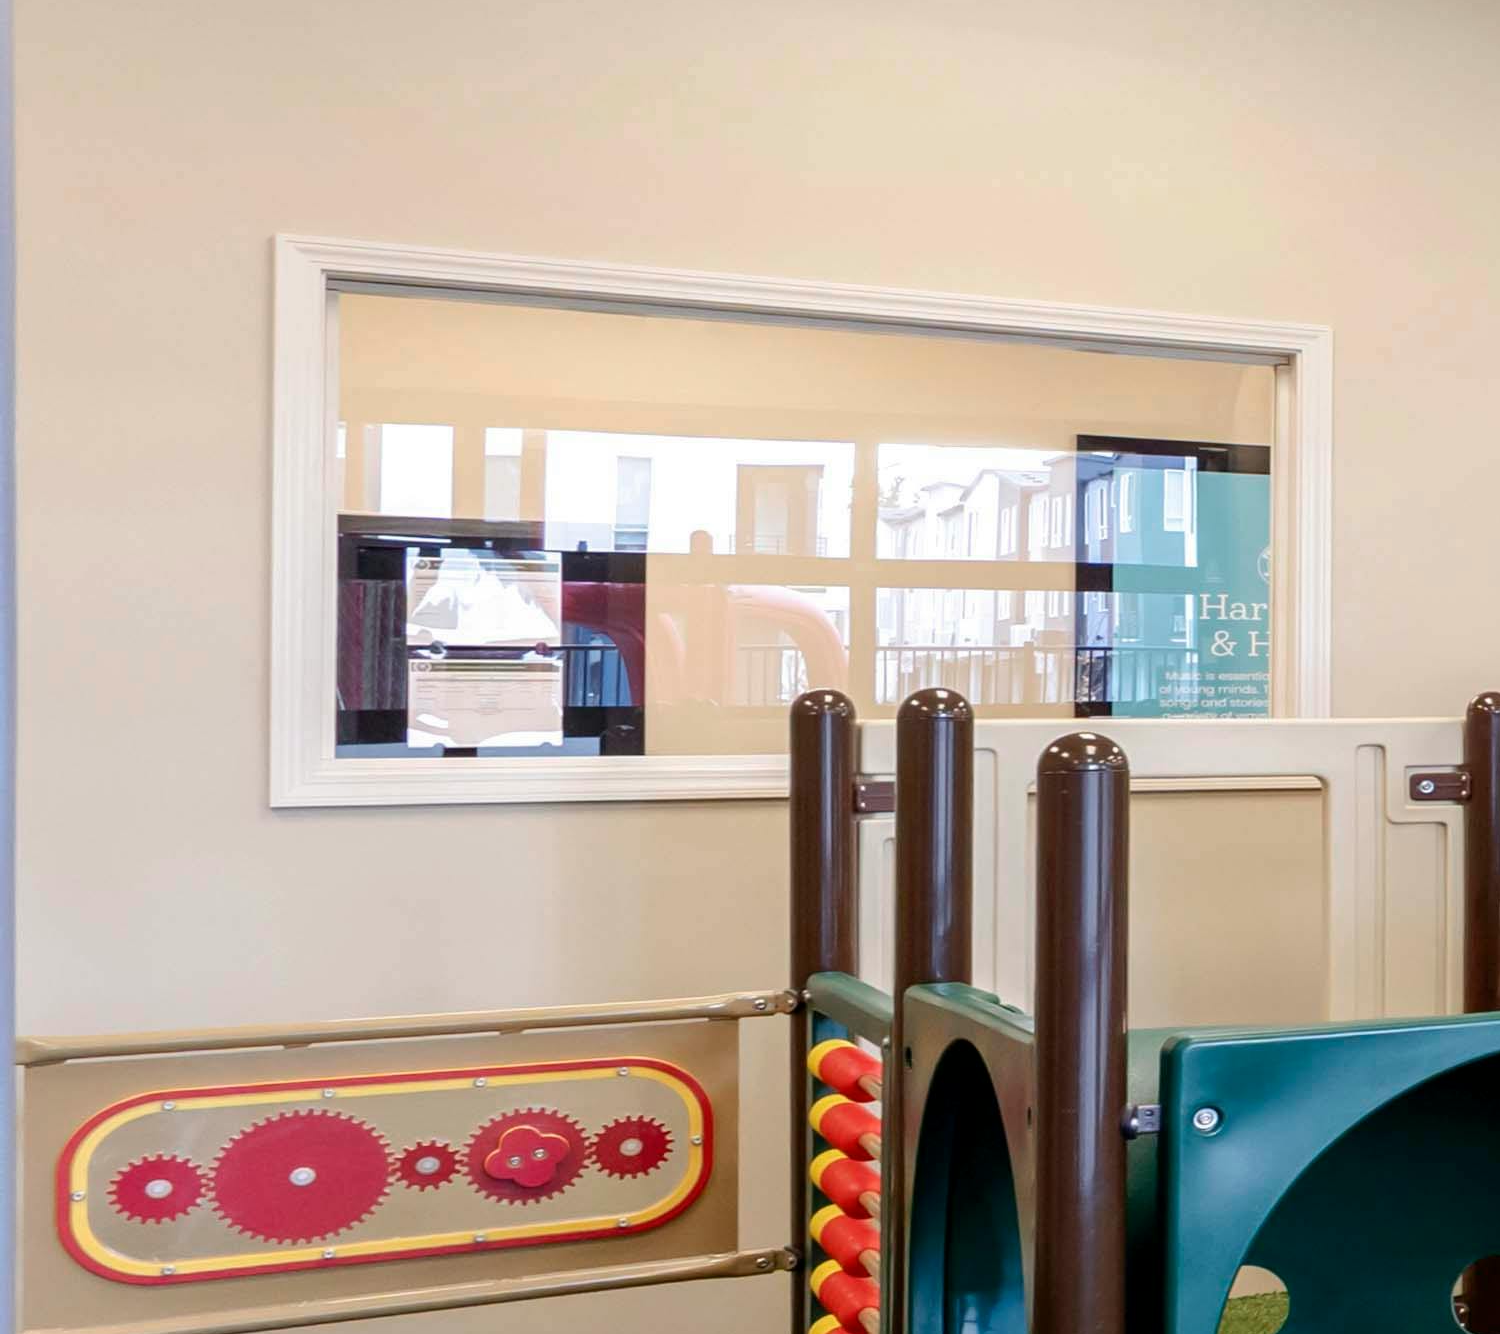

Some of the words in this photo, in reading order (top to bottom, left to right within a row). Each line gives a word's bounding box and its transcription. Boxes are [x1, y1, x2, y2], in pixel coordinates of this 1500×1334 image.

[1199, 594, 1268, 620] Har
[1211, 630, 1237, 656] &
[1201, 698, 1227, 708] and
